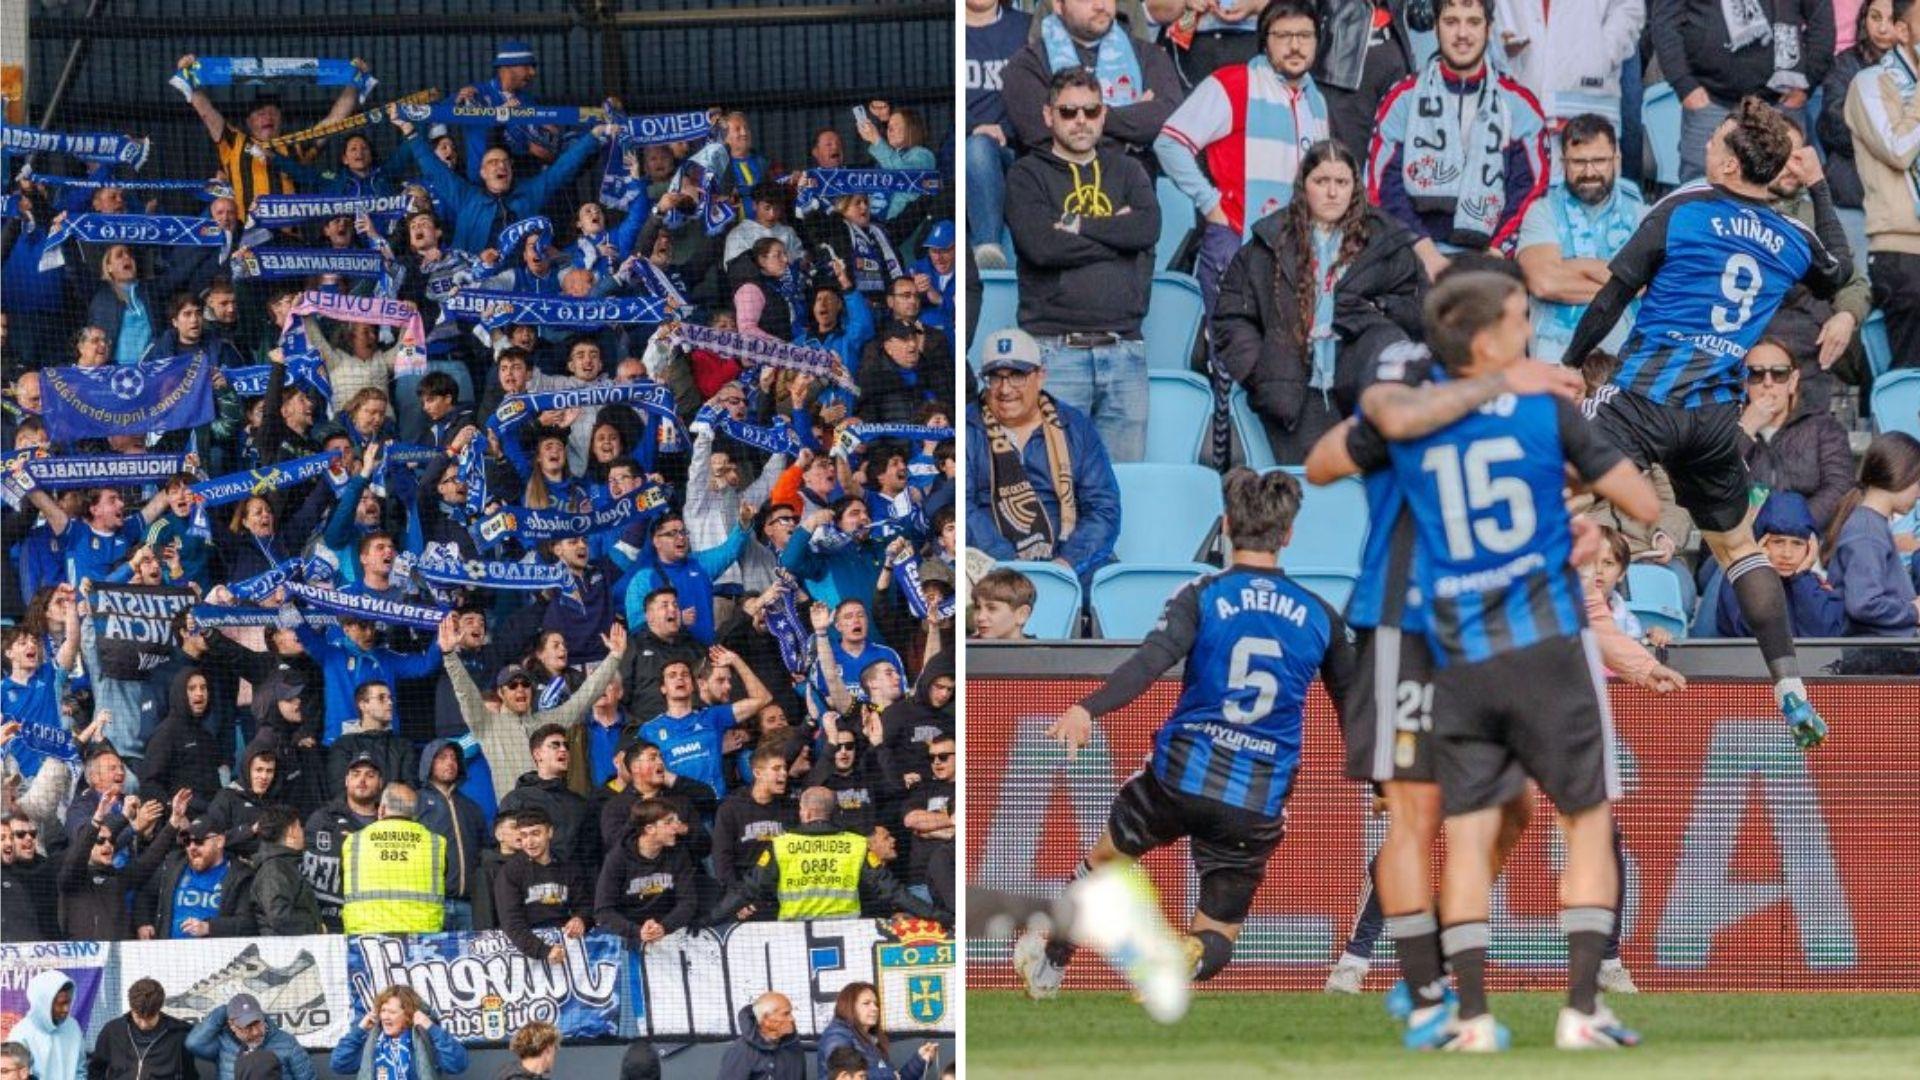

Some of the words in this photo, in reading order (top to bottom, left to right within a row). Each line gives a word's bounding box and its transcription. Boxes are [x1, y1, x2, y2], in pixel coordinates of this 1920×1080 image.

[1711, 253, 1763, 333] 9
[1422, 436, 1537, 561] 15
[1223, 636, 1284, 724] 5
[1204, 721, 1277, 755] HYUNDAI
